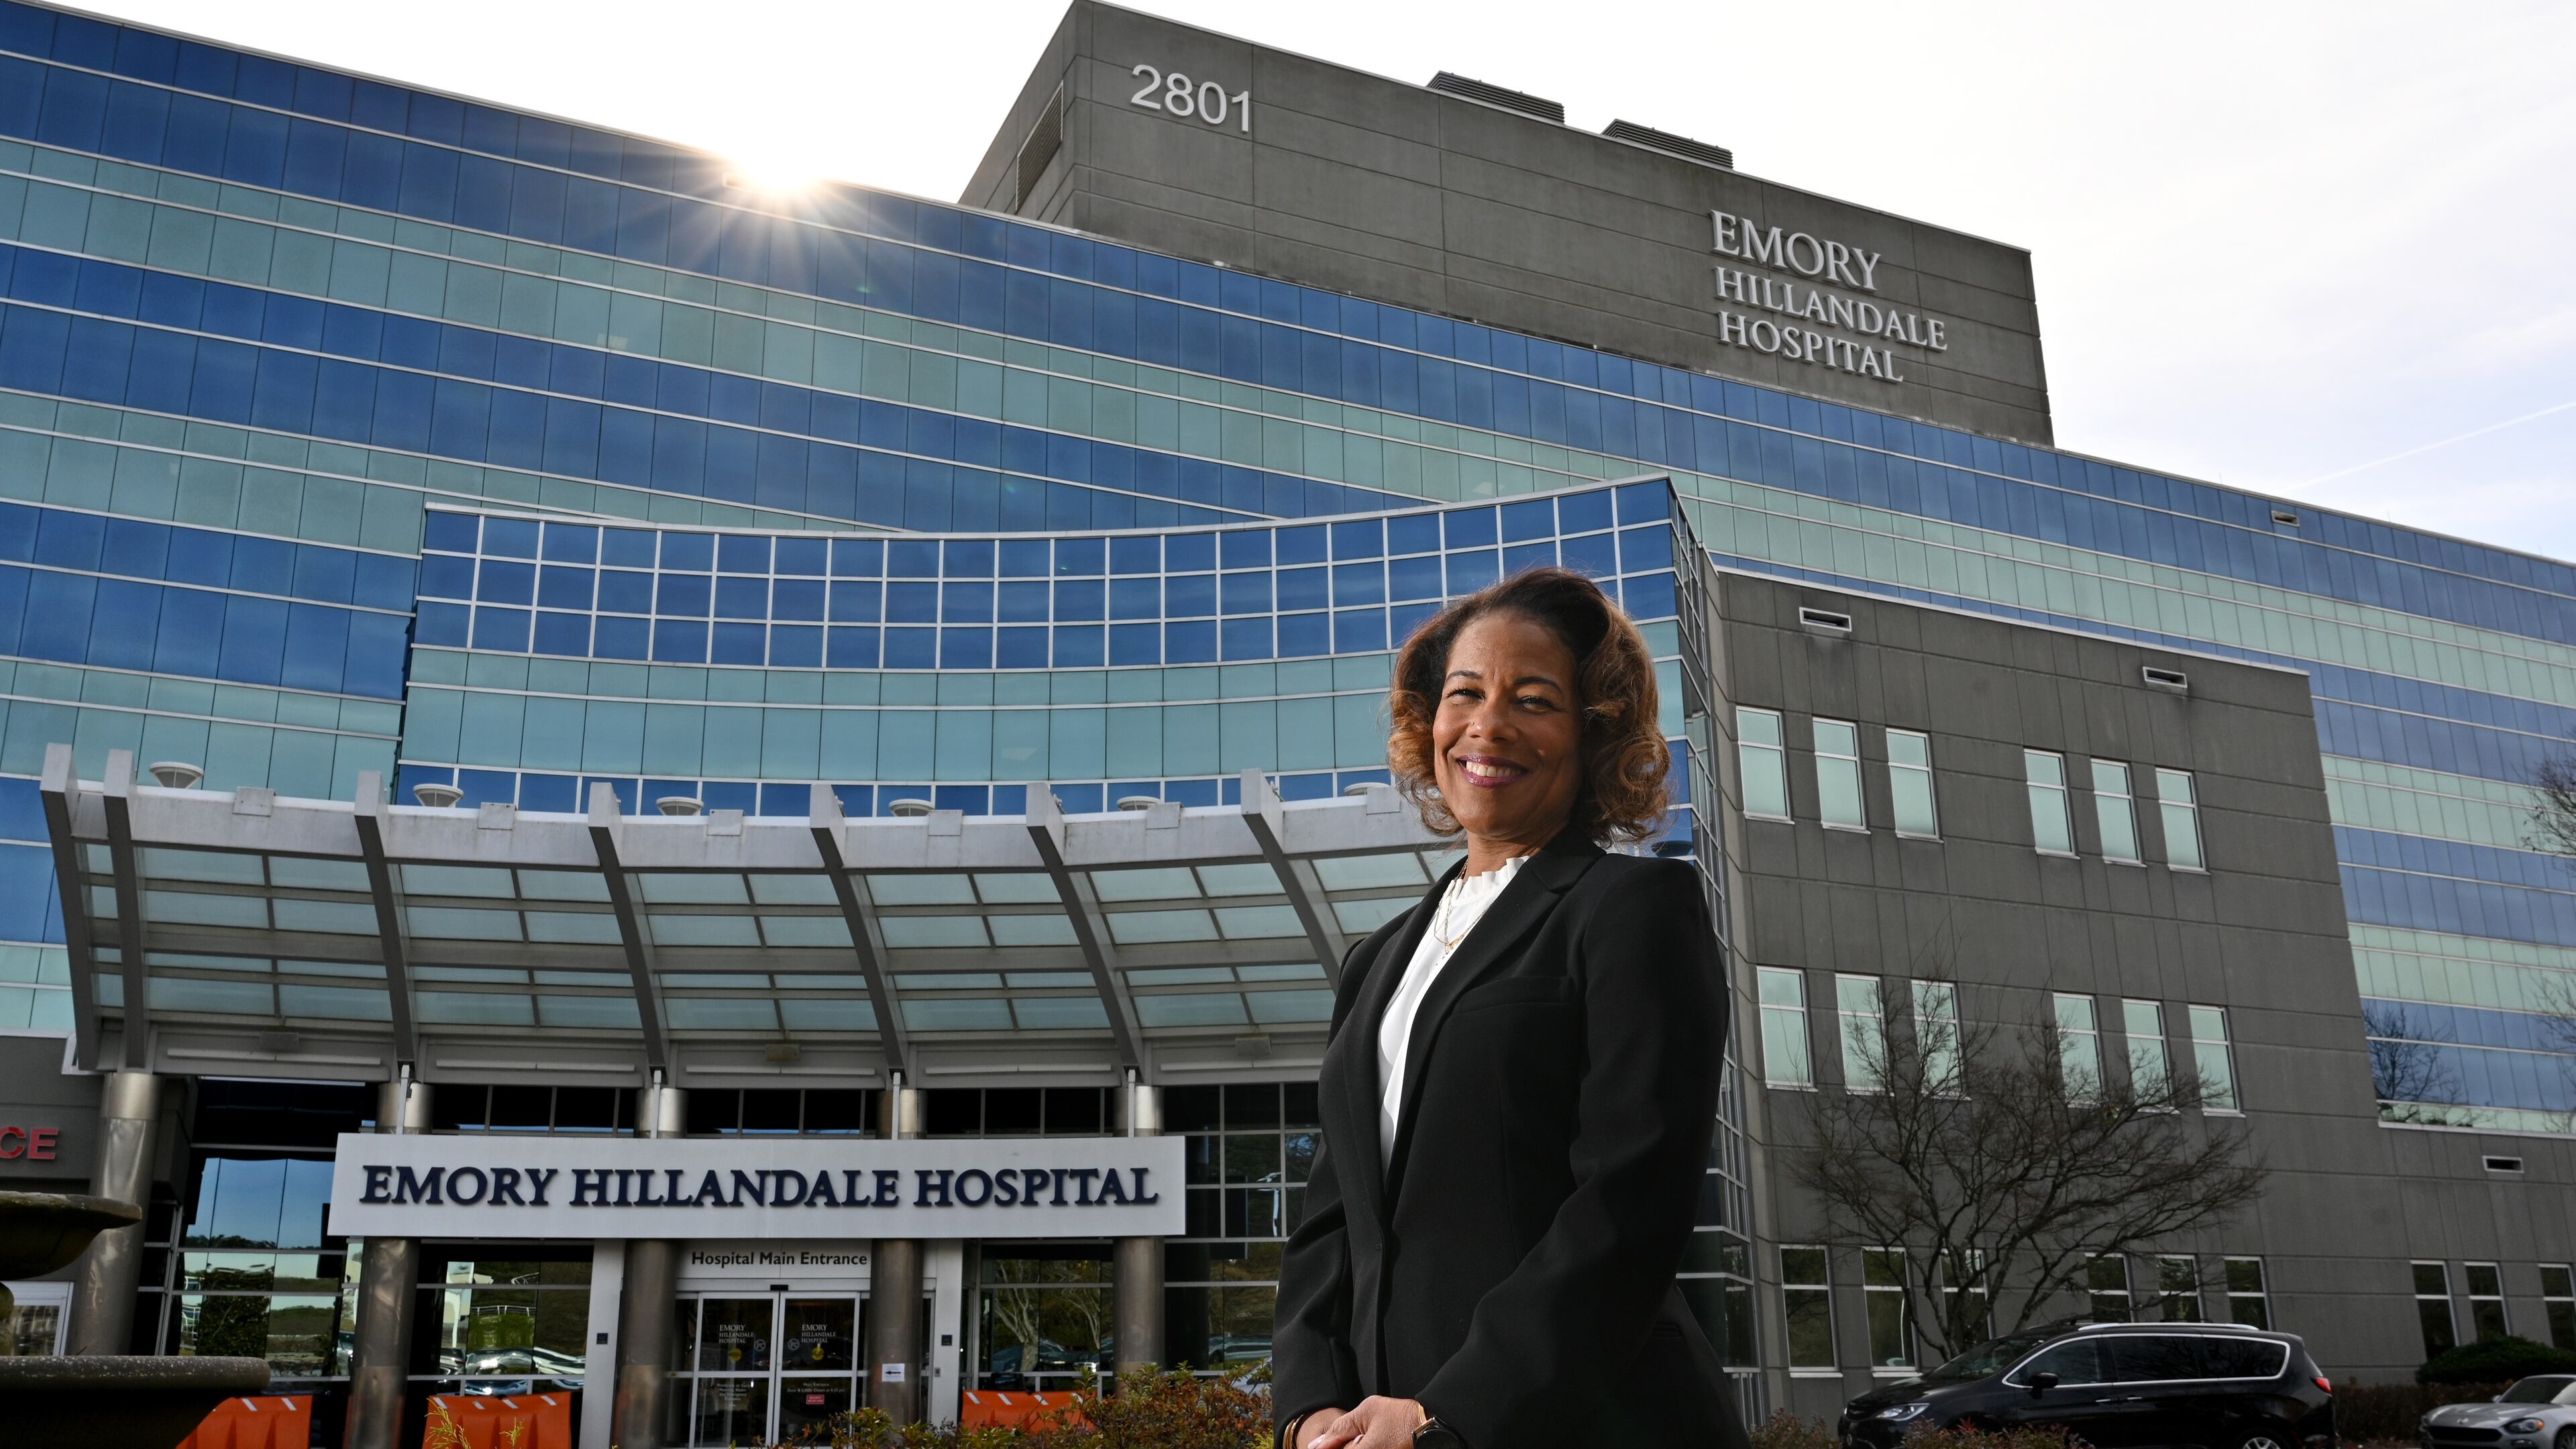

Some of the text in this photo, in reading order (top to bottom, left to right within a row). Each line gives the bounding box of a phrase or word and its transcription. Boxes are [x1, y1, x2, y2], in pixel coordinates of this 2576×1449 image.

[1130, 64, 1249, 133] 2801
[1709, 209, 1881, 292] EMORY
[1713, 266, 1948, 352] HILLANDALE
[1717, 310, 1904, 384] HOSPITAL
[0, 1126, 60, 1160] CE
[359, 1165, 1159, 1208] EMORY HILLANDALE HOSPITAL
[692, 1251, 868, 1269] Hospital Main Entrance
